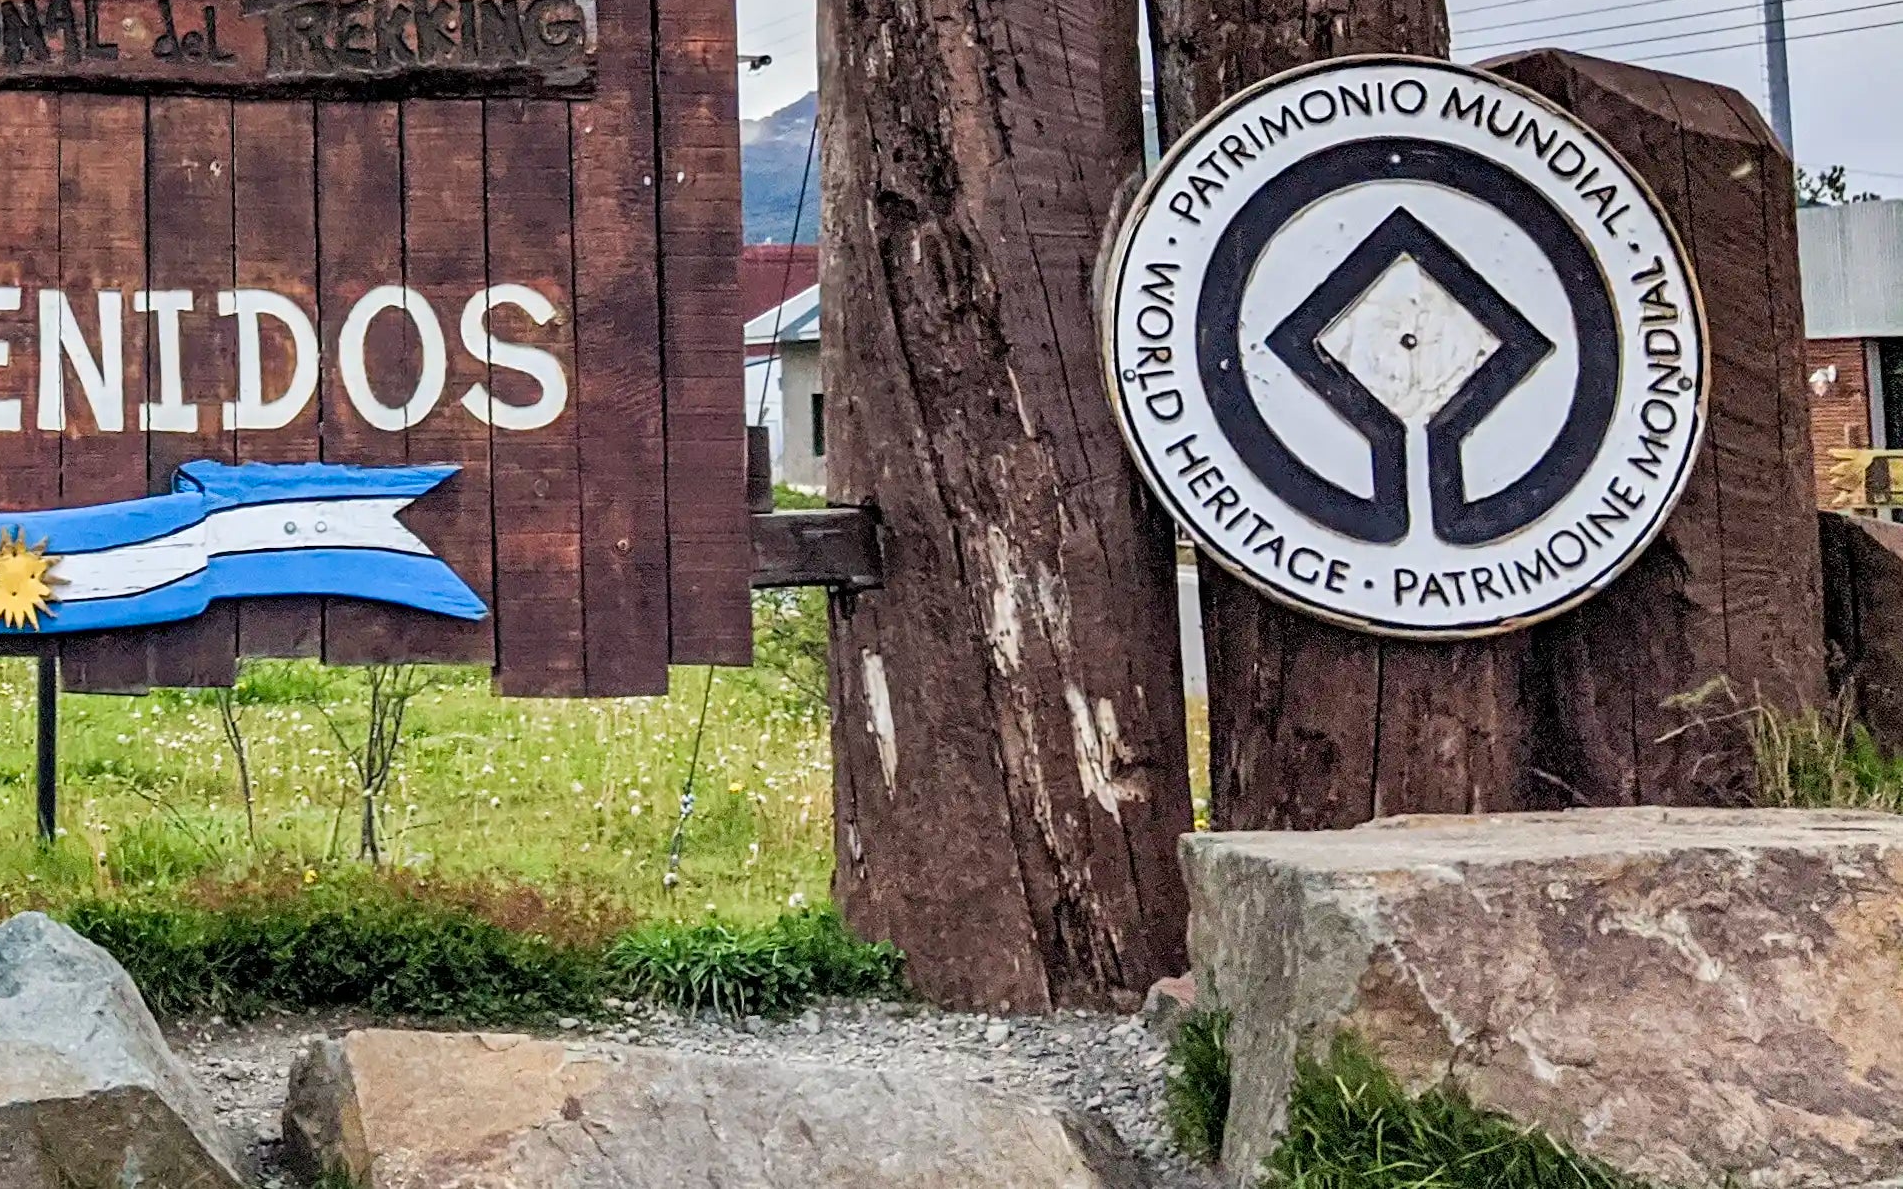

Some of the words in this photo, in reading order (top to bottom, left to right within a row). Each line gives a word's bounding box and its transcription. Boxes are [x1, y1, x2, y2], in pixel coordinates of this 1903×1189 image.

[1169, 78, 1428, 226] PATRIMONIO
[1440, 85, 1634, 239] MUNDIAL
[1135, 261, 1186, 424] WORLD
[1164, 433, 1352, 593] HERITAGE
[1393, 475, 1647, 607] PATRIMOINE
[1628, 256, 1682, 484] MONDIAL
